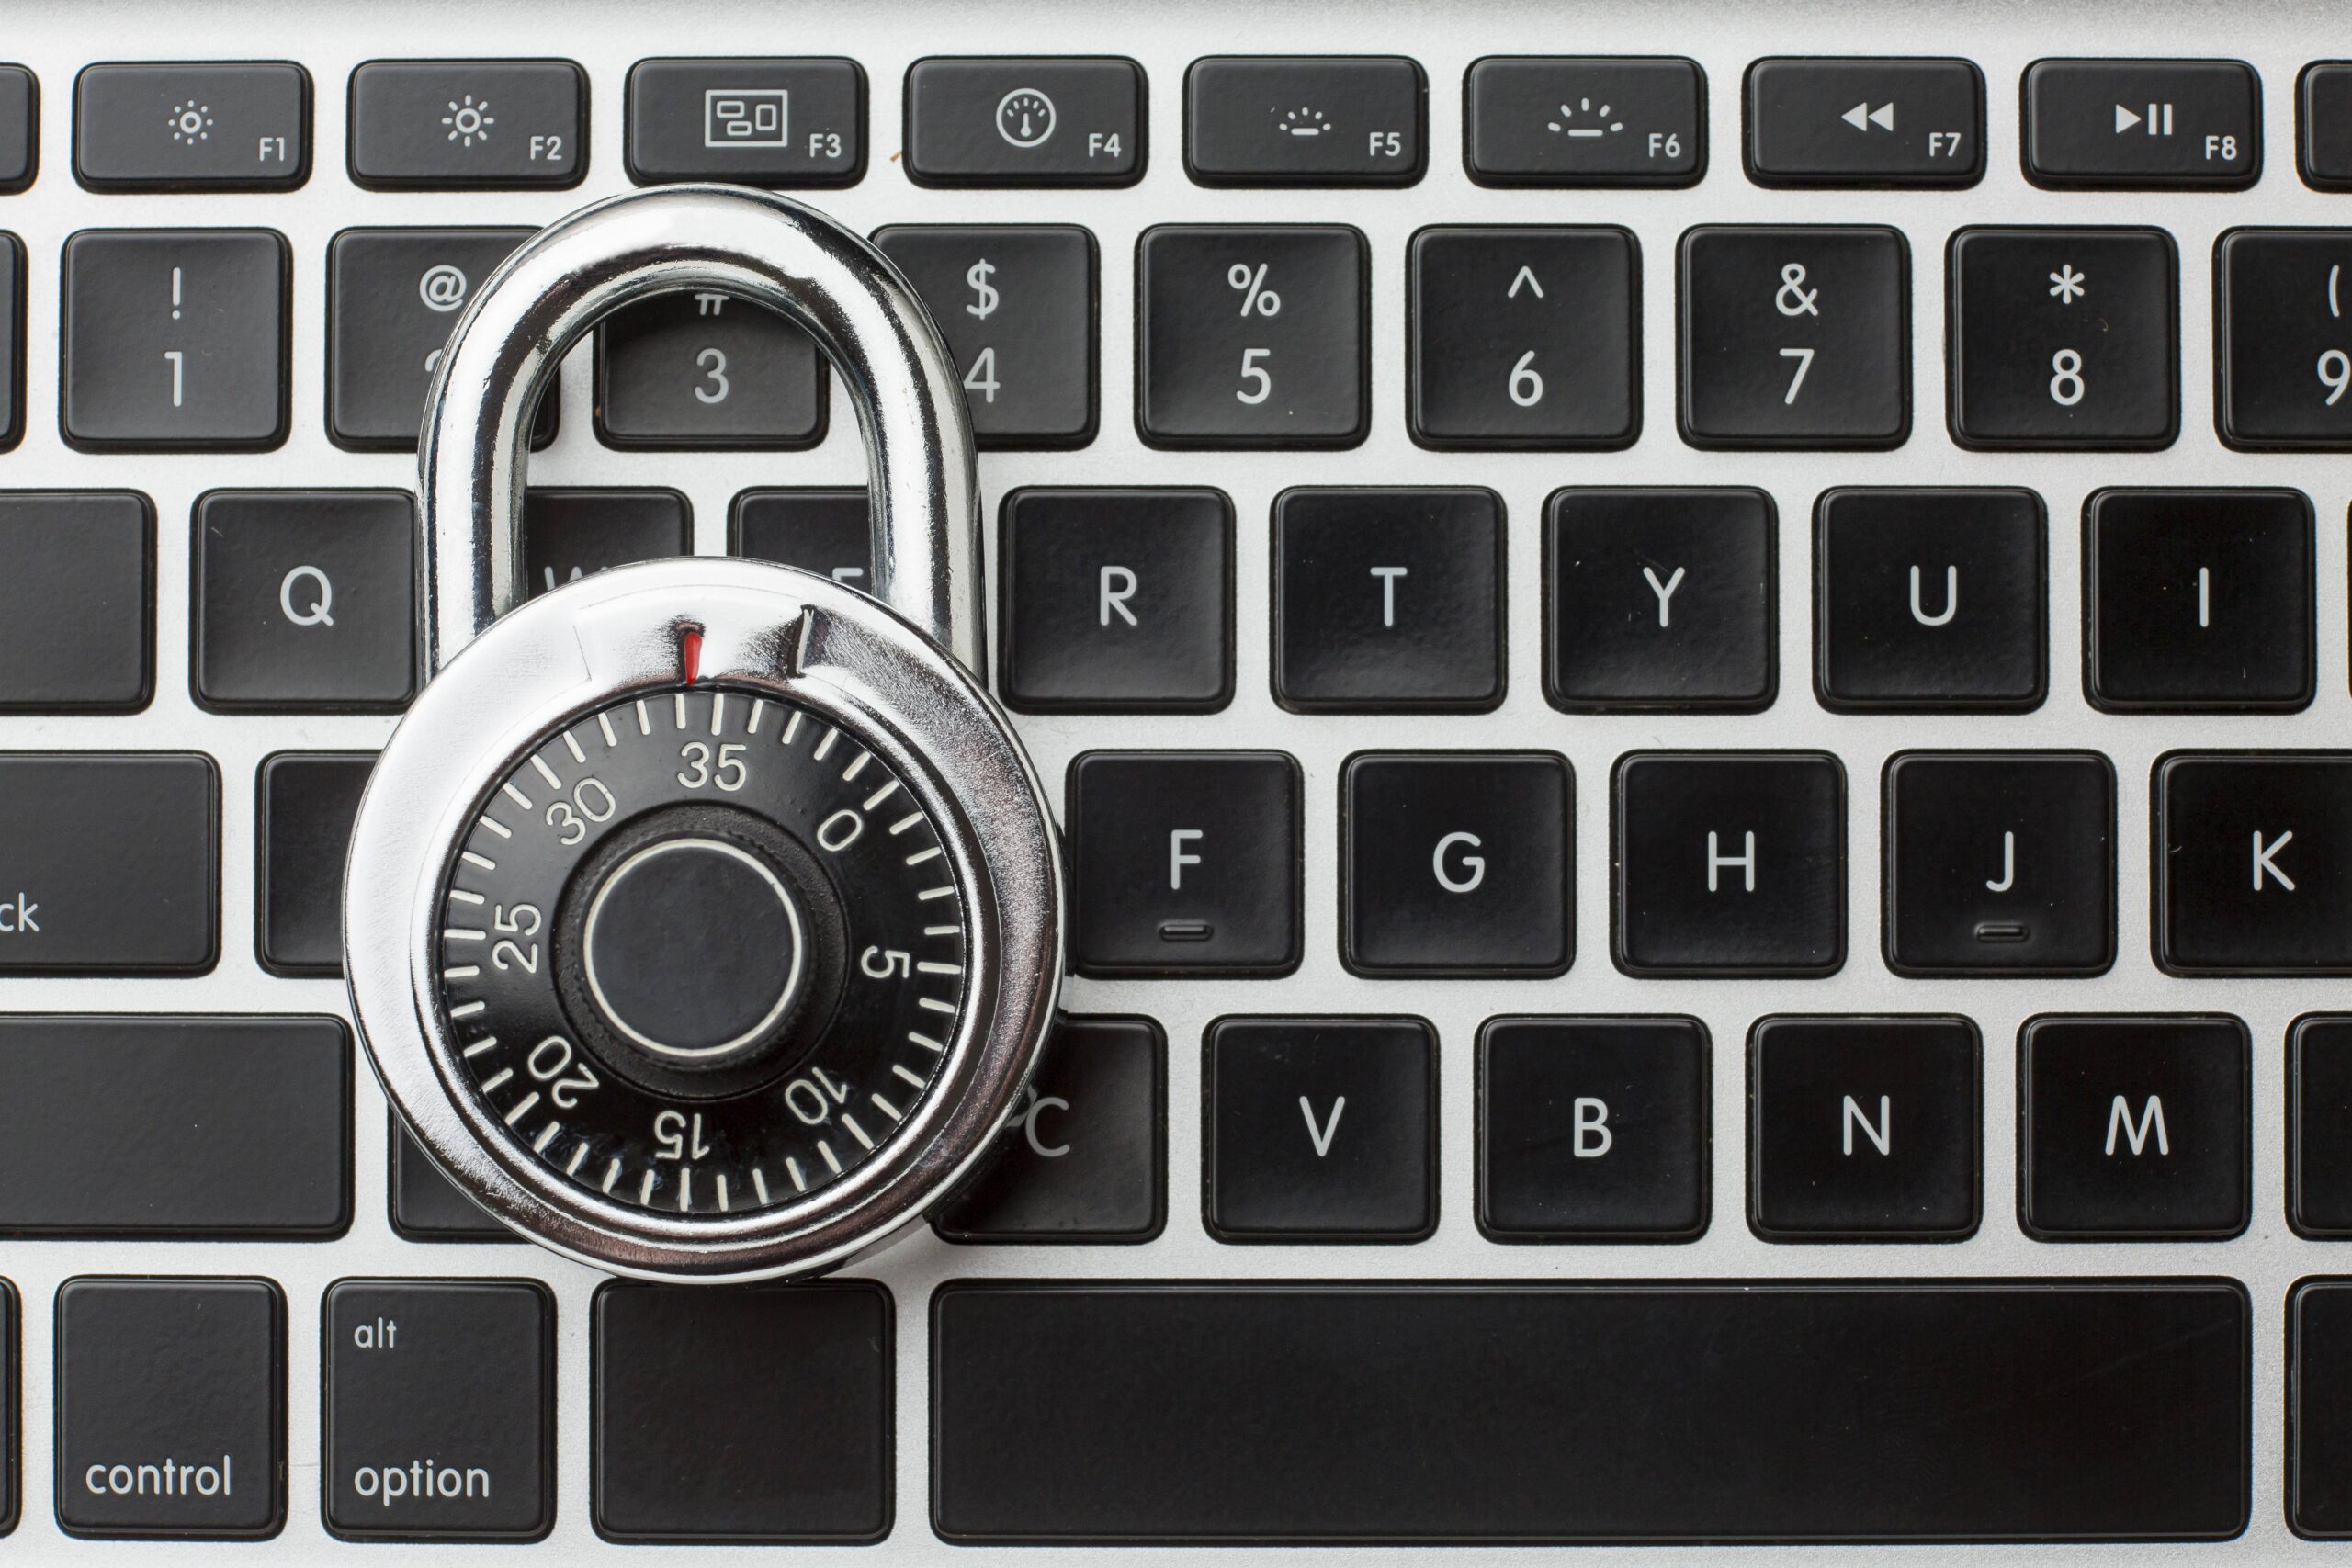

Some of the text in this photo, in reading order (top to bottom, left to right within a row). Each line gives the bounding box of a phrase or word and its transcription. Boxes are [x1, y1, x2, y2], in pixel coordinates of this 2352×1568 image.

[259, 137, 285, 162] F1
[530, 135, 562, 161] F2
[809, 133, 842, 158] F3
[1089, 132, 1122, 158] F4
[1369, 131, 1401, 157] F5
[1648, 132, 1681, 158] F6
[1929, 132, 1962, 157] F7
[2205, 135, 2237, 161] F8
[172, 267, 181, 320] !
[419, 265, 467, 312] @
[966, 257, 1000, 321] $
[1227, 263, 1281, 317] %
[1508, 265, 1544, 299] ^
[1775, 263, 1819, 317] &
[2328, 265, 2340, 318] (
[164, 351, 183, 407] 1
[695, 348, 729, 404] 3
[963, 346, 1001, 403] 4
[1236, 348, 1272, 405] 5
[1508, 350, 1544, 407] 6
[1779, 348, 1815, 405] 7
[2050, 348, 2085, 406] 8
[2316, 349, 2351, 406] 9
[279, 565, 334, 626] Q
[1100, 566, 1138, 626] R
[1370, 567, 1408, 627] T
[1643, 567, 1685, 627] Y
[1910, 565, 1957, 626] U
[2199, 567, 2210, 627] I
[677, 741, 747, 792] 35
[546, 778, 616, 846] 30
[816, 809, 863, 852] 0
[1170, 829, 1204, 890] F
[1432, 831, 1486, 893] G
[1708, 830, 1755, 892] H
[1985, 830, 2014, 892] J
[2253, 830, 2296, 891] K
[492, 904, 542, 974] 25
[860, 945, 910, 979] 5
[527, 1035, 600, 1109] 20
[785, 1066, 848, 1125] 10
[654, 1110, 710, 1160] 15
[1024, 1096, 1070, 1158] C
[1299, 1095, 1346, 1157] V
[1573, 1097, 1612, 1157] B
[1843, 1095, 1890, 1156] N
[2105, 1095, 2169, 1156] M
[354, 1316, 397, 1348] alt
[85, 1454, 231, 1495] control
[354, 1459, 490, 1507] option
